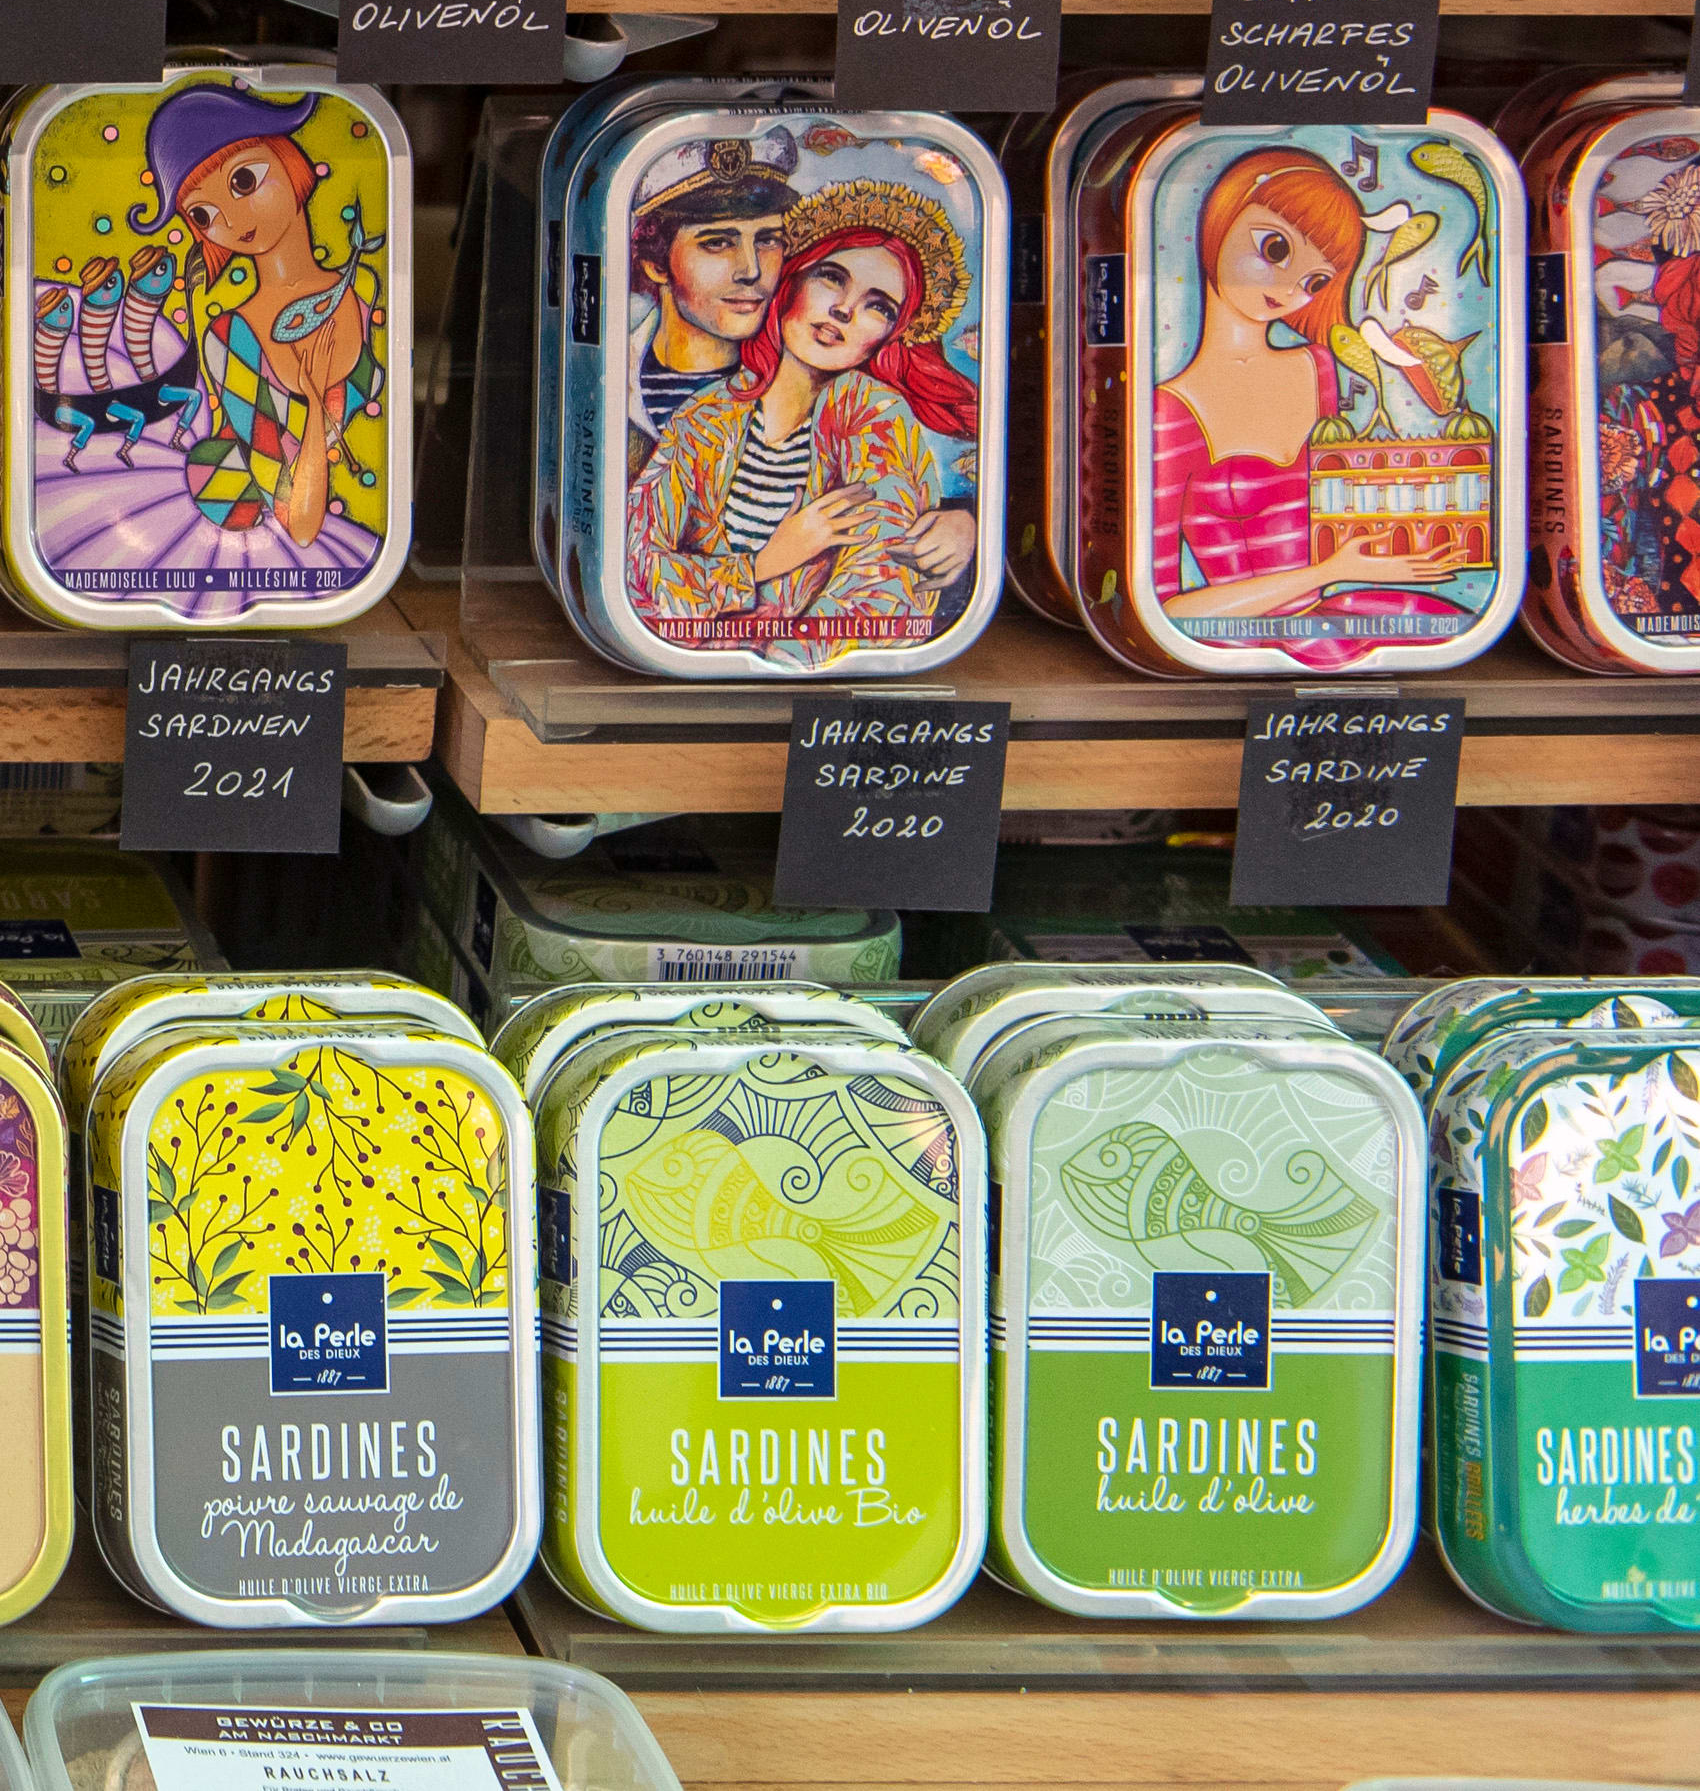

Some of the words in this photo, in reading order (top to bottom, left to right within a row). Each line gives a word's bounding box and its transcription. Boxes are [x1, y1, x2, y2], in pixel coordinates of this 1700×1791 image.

[1220, 21, 1415, 49] SCHARFES
[801, 718, 994, 748] JAHRGANGS
[816, 762, 971, 788] SARDINE
[844, 806, 944, 839] 2020
[222, 1421, 439, 1484] SARDINES
[669, 1428, 887, 1487] SARDINES
[1096, 1417, 1317, 1476] SARDINES
[1096, 1476, 1185, 1512] huile
[1199, 1478, 1314, 1513] d'olive
[219, 1519, 440, 1577] Madagascar
[264, 1764, 391, 1784] RAUCHSALZ
